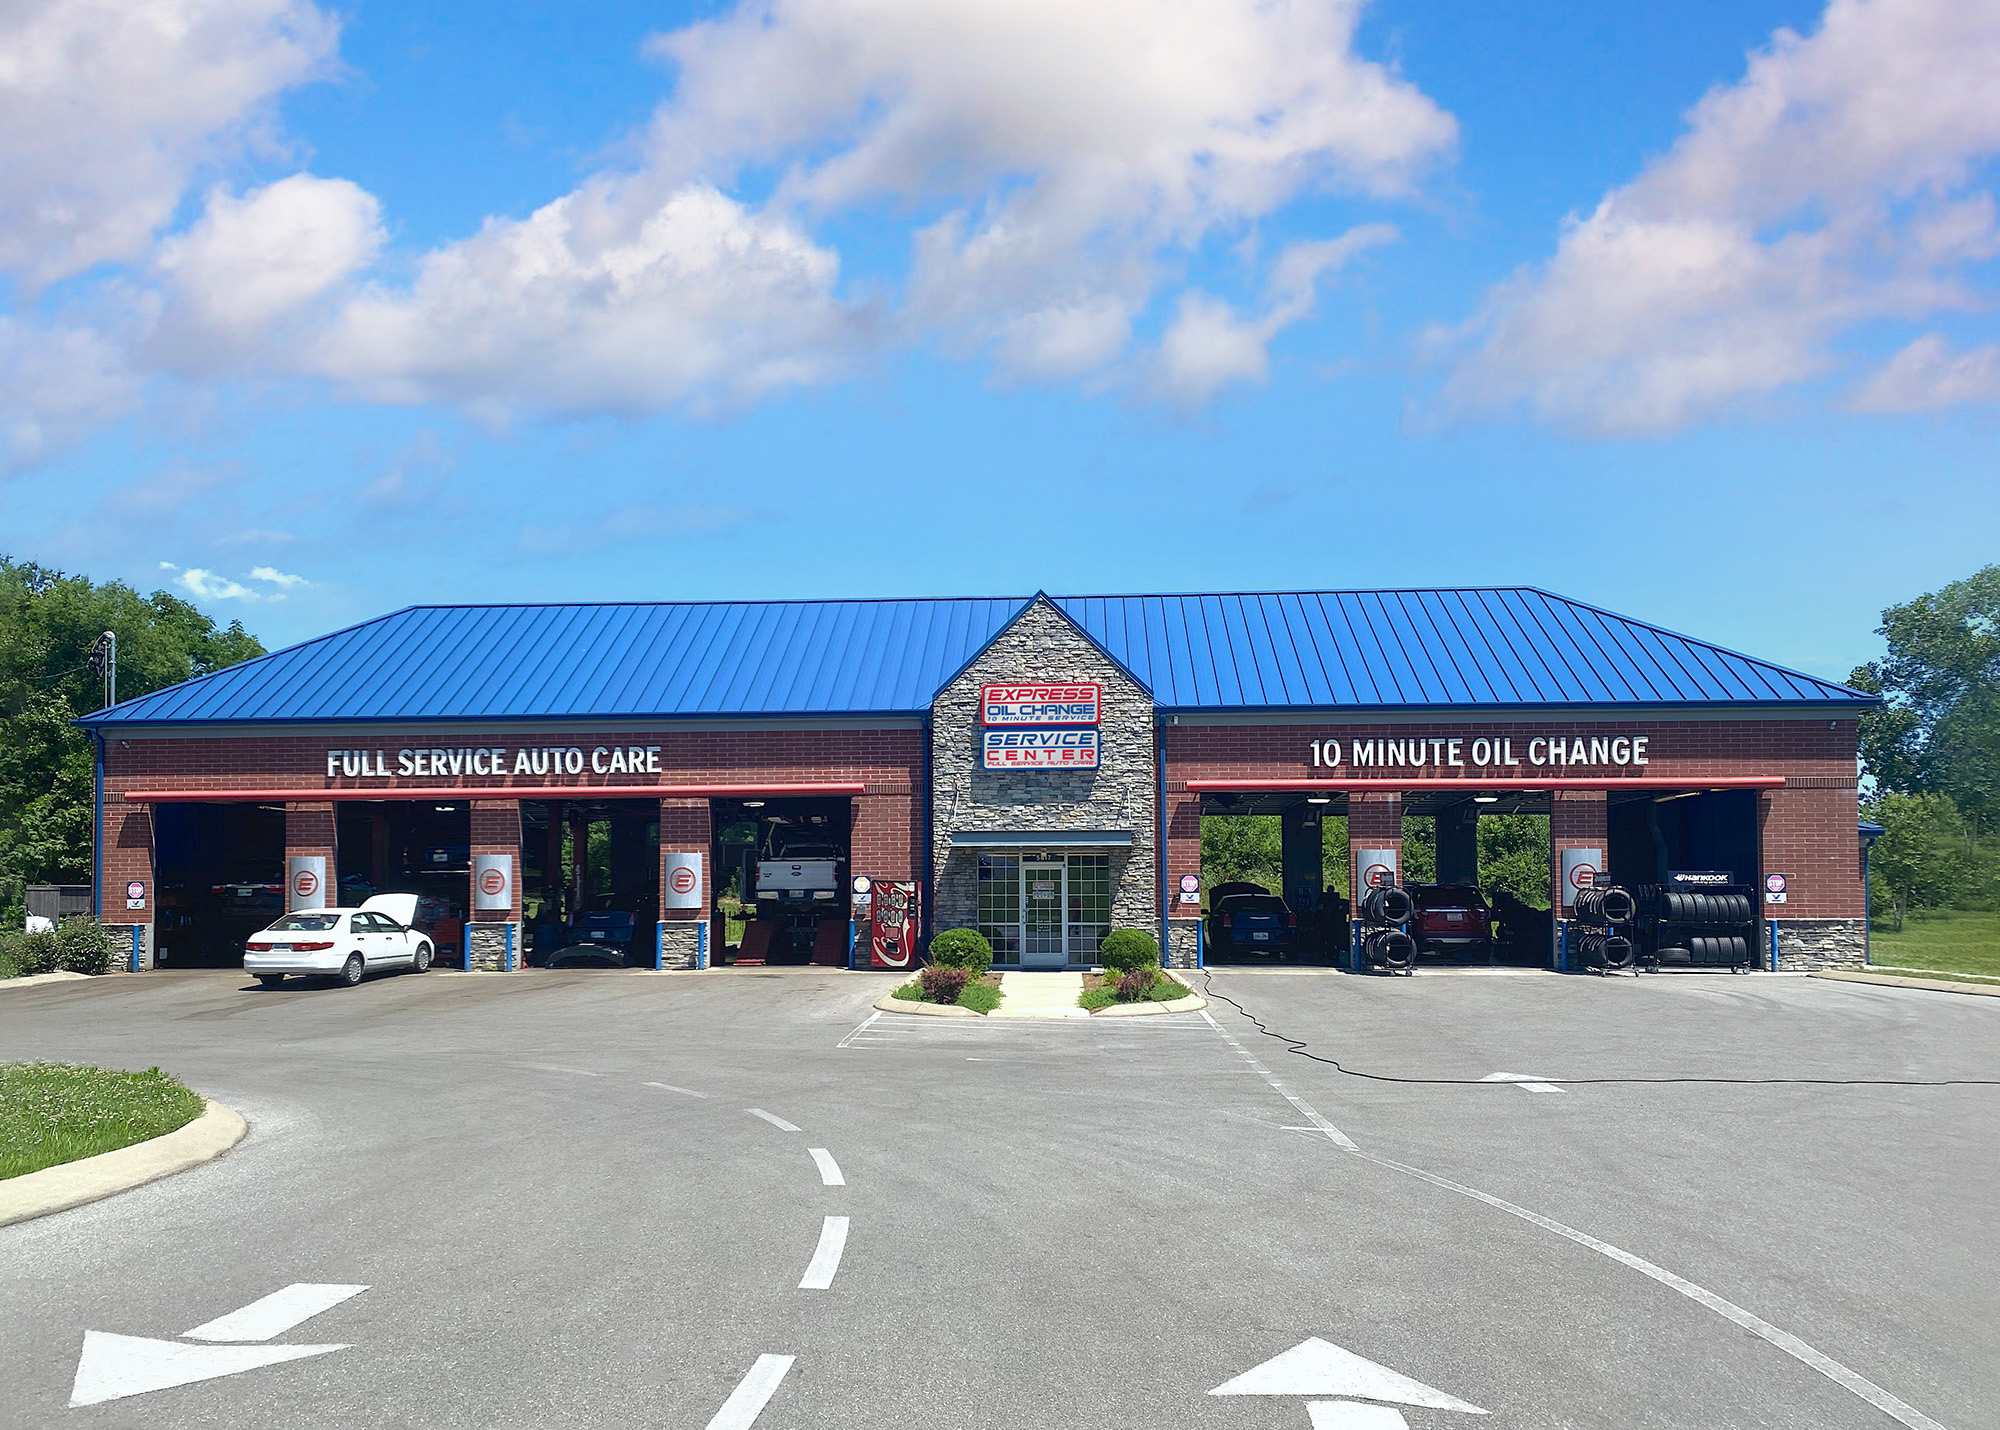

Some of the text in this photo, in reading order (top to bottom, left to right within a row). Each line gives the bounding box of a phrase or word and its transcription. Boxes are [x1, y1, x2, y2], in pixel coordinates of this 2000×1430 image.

[987, 687, 1095, 701] EXPRESS
[987, 704, 1095, 716] OIL CHANGE
[987, 733, 1095, 746] SERVICE
[987, 749, 1095, 760] CENTER
[1309, 736, 1650, 767] 10 MINUTE OIL CHANGE
[327, 746, 663, 777] FULL SERVICE AUTO CARE
[484, 875, 501, 889] E
[675, 874, 692, 888] E
[1576, 871, 1594, 884] E
[297, 878, 314, 891] E
